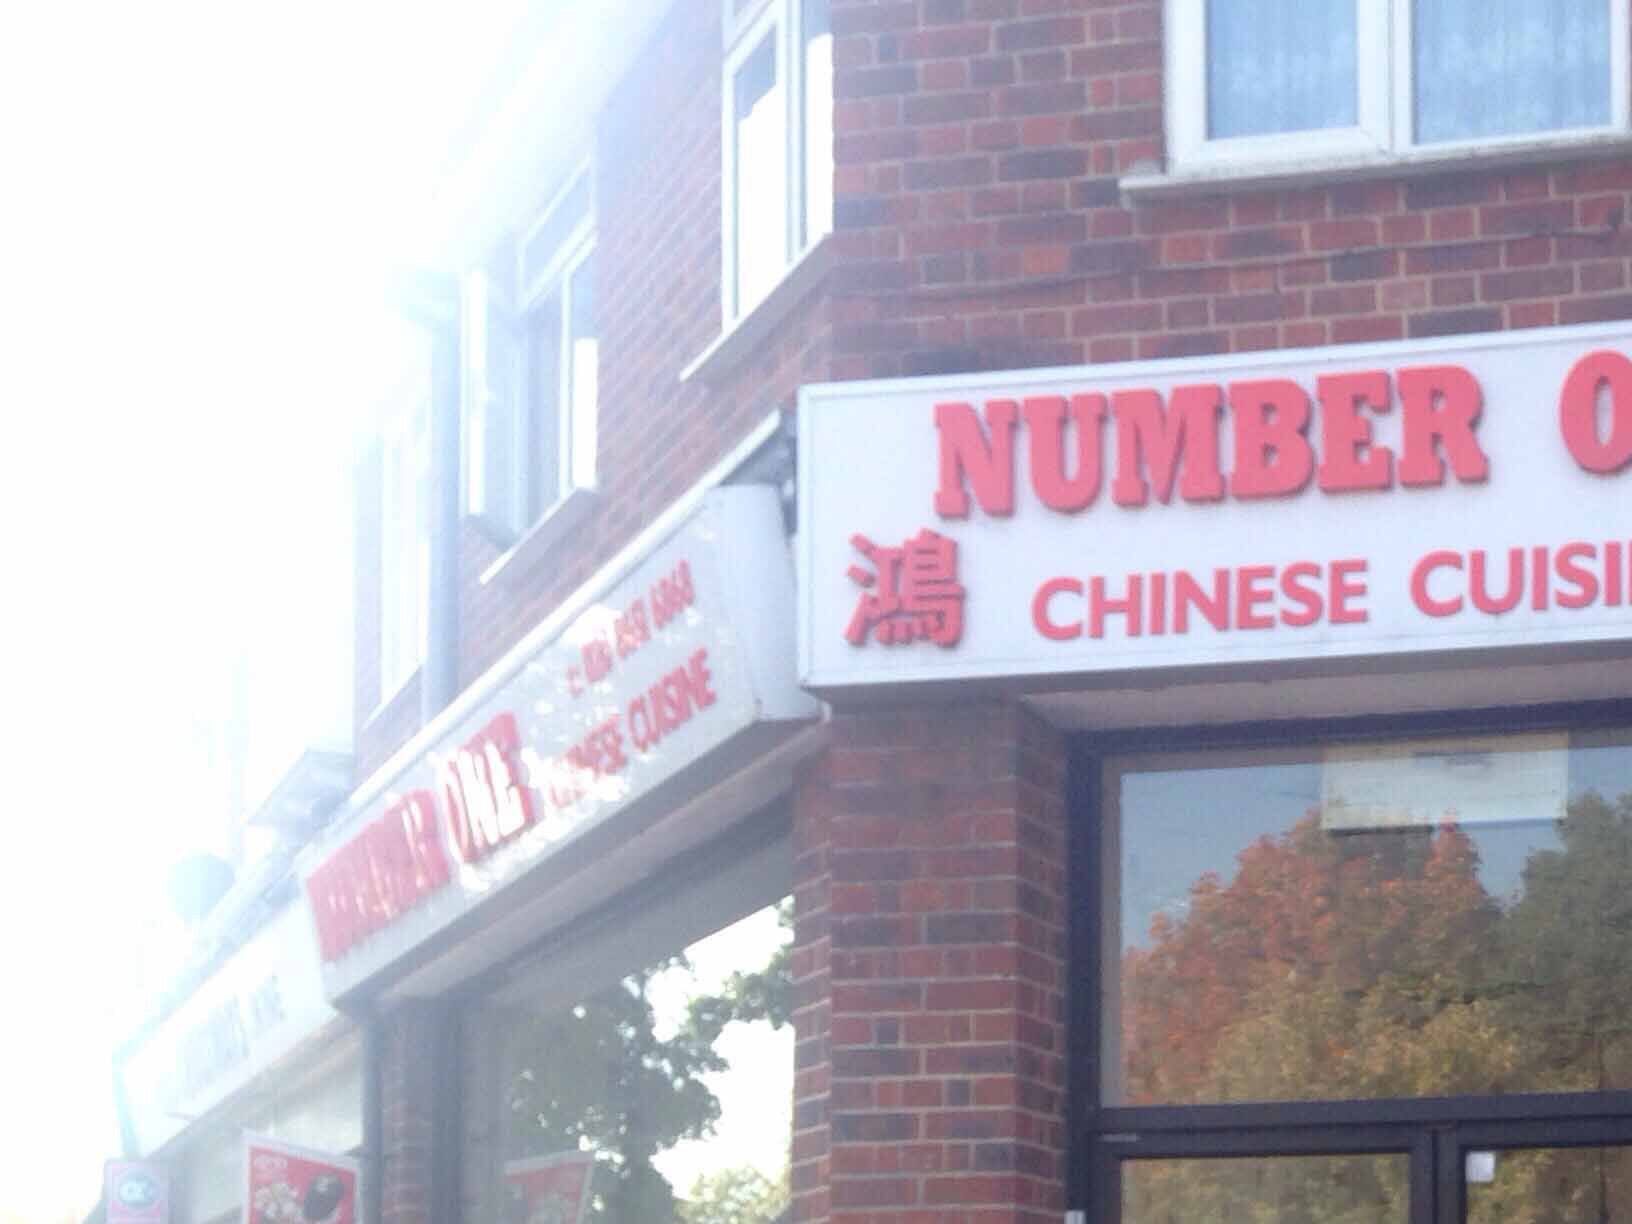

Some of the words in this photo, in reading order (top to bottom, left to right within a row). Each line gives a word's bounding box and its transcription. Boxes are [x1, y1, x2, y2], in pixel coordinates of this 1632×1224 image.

[933, 364, 1489, 521] NUMBER
[844, 527, 966, 648] 鴻
[1030, 558, 1369, 642] CHINESE
